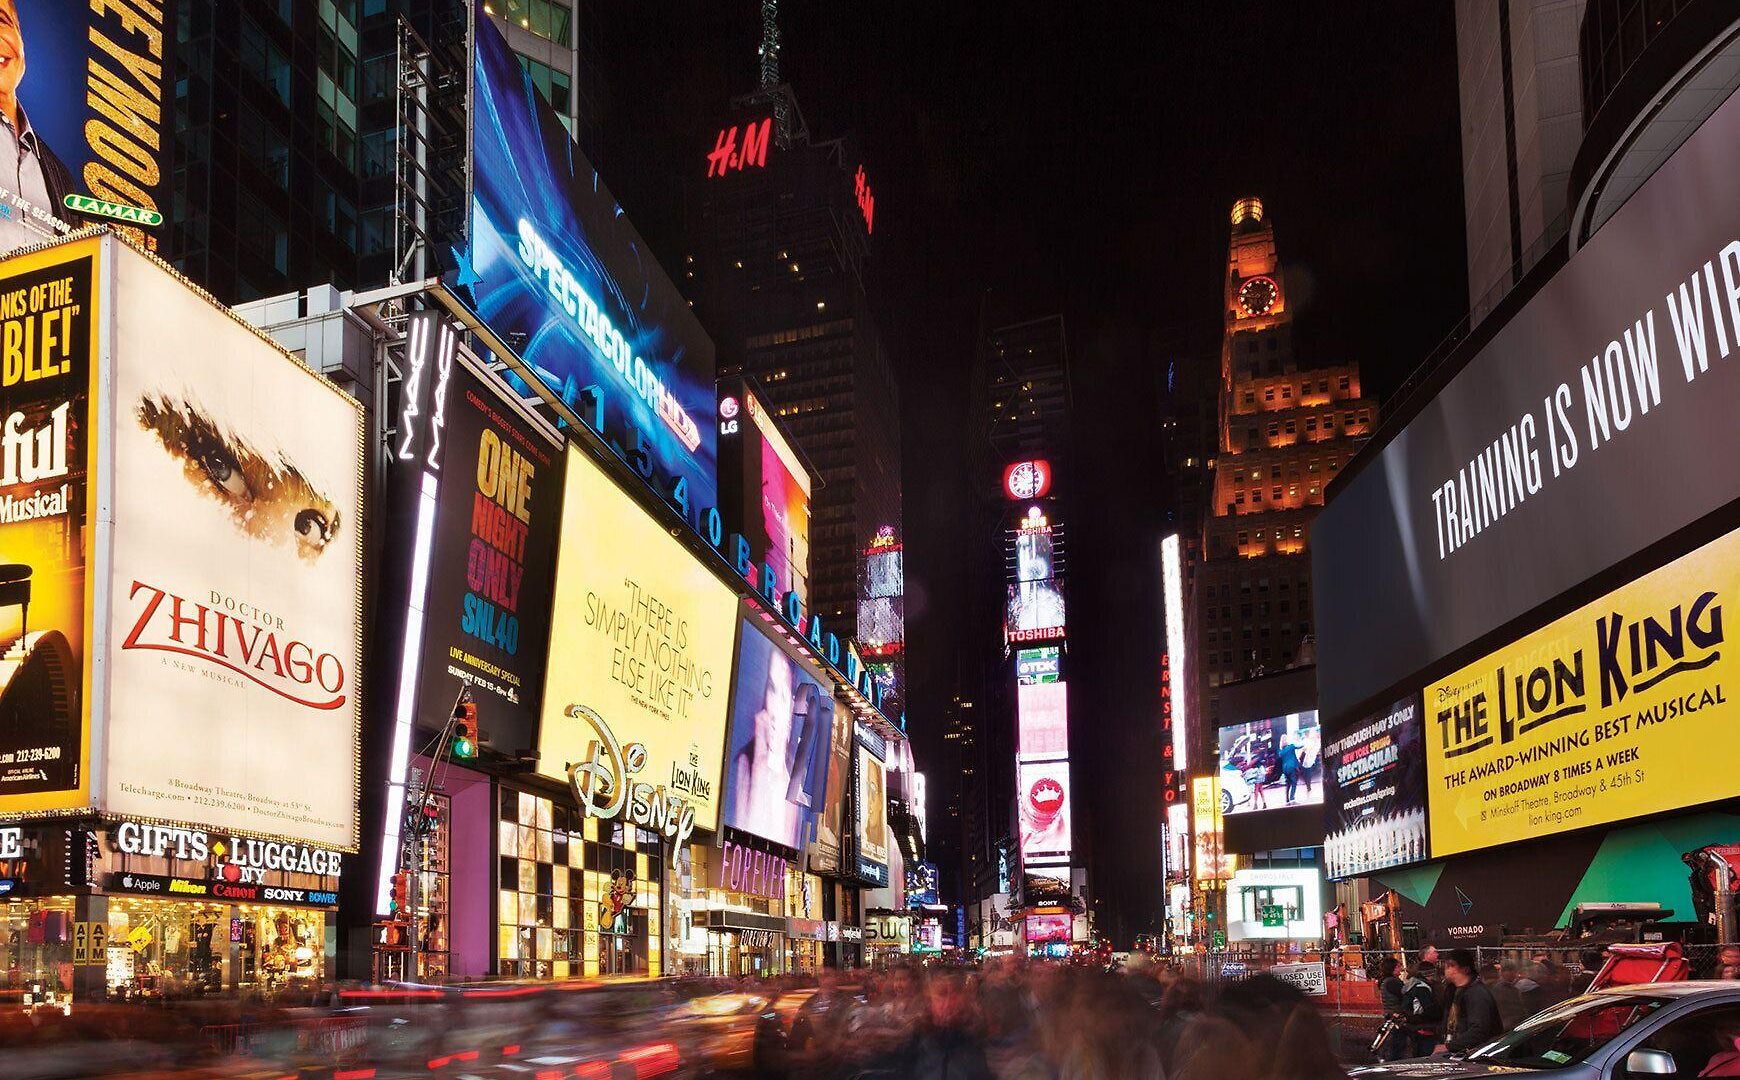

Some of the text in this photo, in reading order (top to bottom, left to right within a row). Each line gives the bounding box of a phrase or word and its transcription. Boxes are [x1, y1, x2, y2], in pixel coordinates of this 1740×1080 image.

[707, 118, 771, 178] H&M
[10, 194, 31, 214] THE
[31, 207, 71, 234] SEASON
[72, 197, 154, 223] LAMAR
[30, 283, 47, 313] OF
[47, 277, 73, 309] THE
[720, 420, 738, 435] LG
[1432, 413, 1542, 560] TRAINING
[1544, 383, 1579, 478] IS
[1581, 308, 1661, 451] NOW
[477, 428, 535, 525] ONE
[0, 483, 68, 524] Musical
[471, 491, 530, 567] NIGHT
[1016, 526, 1052, 536] TOSHIBA
[467, 537, 524, 613] ONLY
[210, 590, 285, 632] DOCTOR
[122, 580, 346, 711] ZHIVAGO
[585, 591, 712, 698] SIMPLY NOTHING
[676, 617, 688, 649] IS
[1008, 627, 1065, 642] TOSHIBA
[160, 657, 246, 689] A NEW MUSICAL
[448, 664, 473, 682] SUNDAY
[474, 675, 487, 688] FEB
[450, 646, 520, 687] LIVE ANNIVERSARY SPECIAL
[611, 647, 646, 694] ELSE
[649, 670, 675, 710] LIKE
[1030, 660, 1057, 672] TDK
[1160, 654, 1172, 730] ERNST
[1324, 705, 1414, 758] NOW THROUGH MAY 3 ONLY
[1437, 691, 1489, 750] THE
[1444, 683, 1726, 791] THE AWARD-WINNING BEST MUSICAL
[1163, 744, 1173, 759] &
[1337, 744, 1399, 783] SPECTACULAR
[1342, 735, 1391, 765] NEW YORK SPRING
[174, 778, 213, 796] Broadway
[247, 793, 280, 808] Broadway
[1483, 746, 1640, 802] ON BROADWAY 8 TIMES A WEEK
[119, 782, 345, 829] Telecharge.com 212.239.6200 DoctorZhivagoBroadway.com
[1490, 802, 1520, 820] Minskoff
[1554, 784, 1597, 803] Broadway
[1599, 779, 1607, 791] &
[1610, 772, 1632, 788] 45th
[1635, 769, 1645, 783] St
[118, 822, 342, 877] GIFTS LUGGAGE
[134, 878, 161, 892] Apple
[169, 879, 207, 894] Nikon
[212, 883, 257, 899] Canon
[264, 889, 304, 901] SONY
[240, 867, 267, 885] NY
[720, 841, 787, 900] FOREVER
[76, 923, 85, 959] ATM
[92, 923, 104, 959] ATM
[1447, 925, 1484, 936] VORNADO
[1303, 979, 1322, 987] SIDE
[1306, 971, 1323, 980] USE
